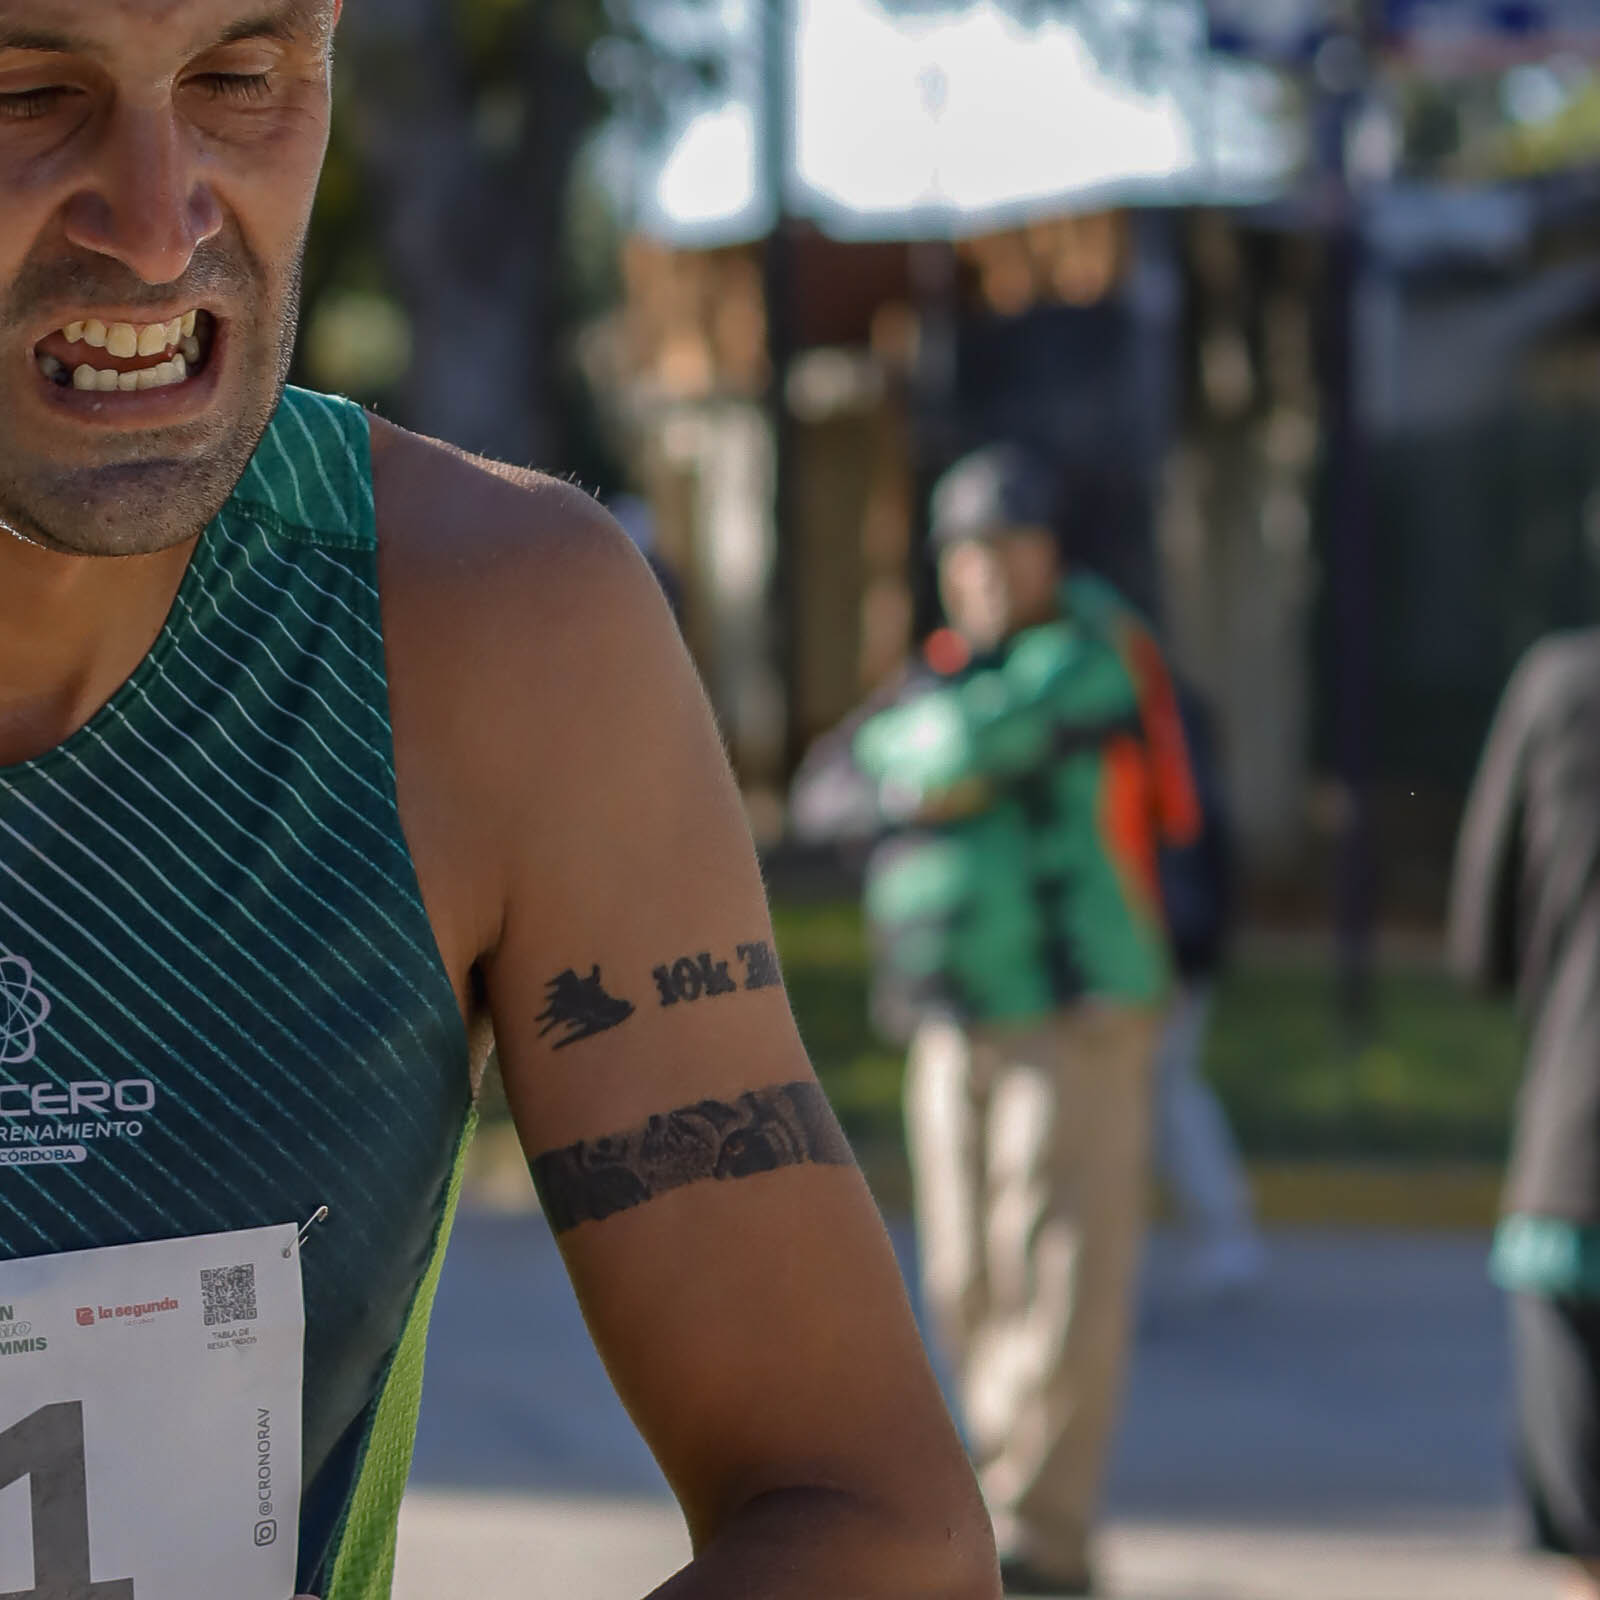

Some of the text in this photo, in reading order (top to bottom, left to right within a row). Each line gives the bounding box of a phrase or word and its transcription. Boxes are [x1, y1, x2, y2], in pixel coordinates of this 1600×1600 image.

[0, 1146, 76, 1164] CÓRDOBA
[99, 1297, 179, 1319] la segunda
[239, 1327, 250, 1337] DE
[257, 1408, 273, 1516] @CRONORAV
